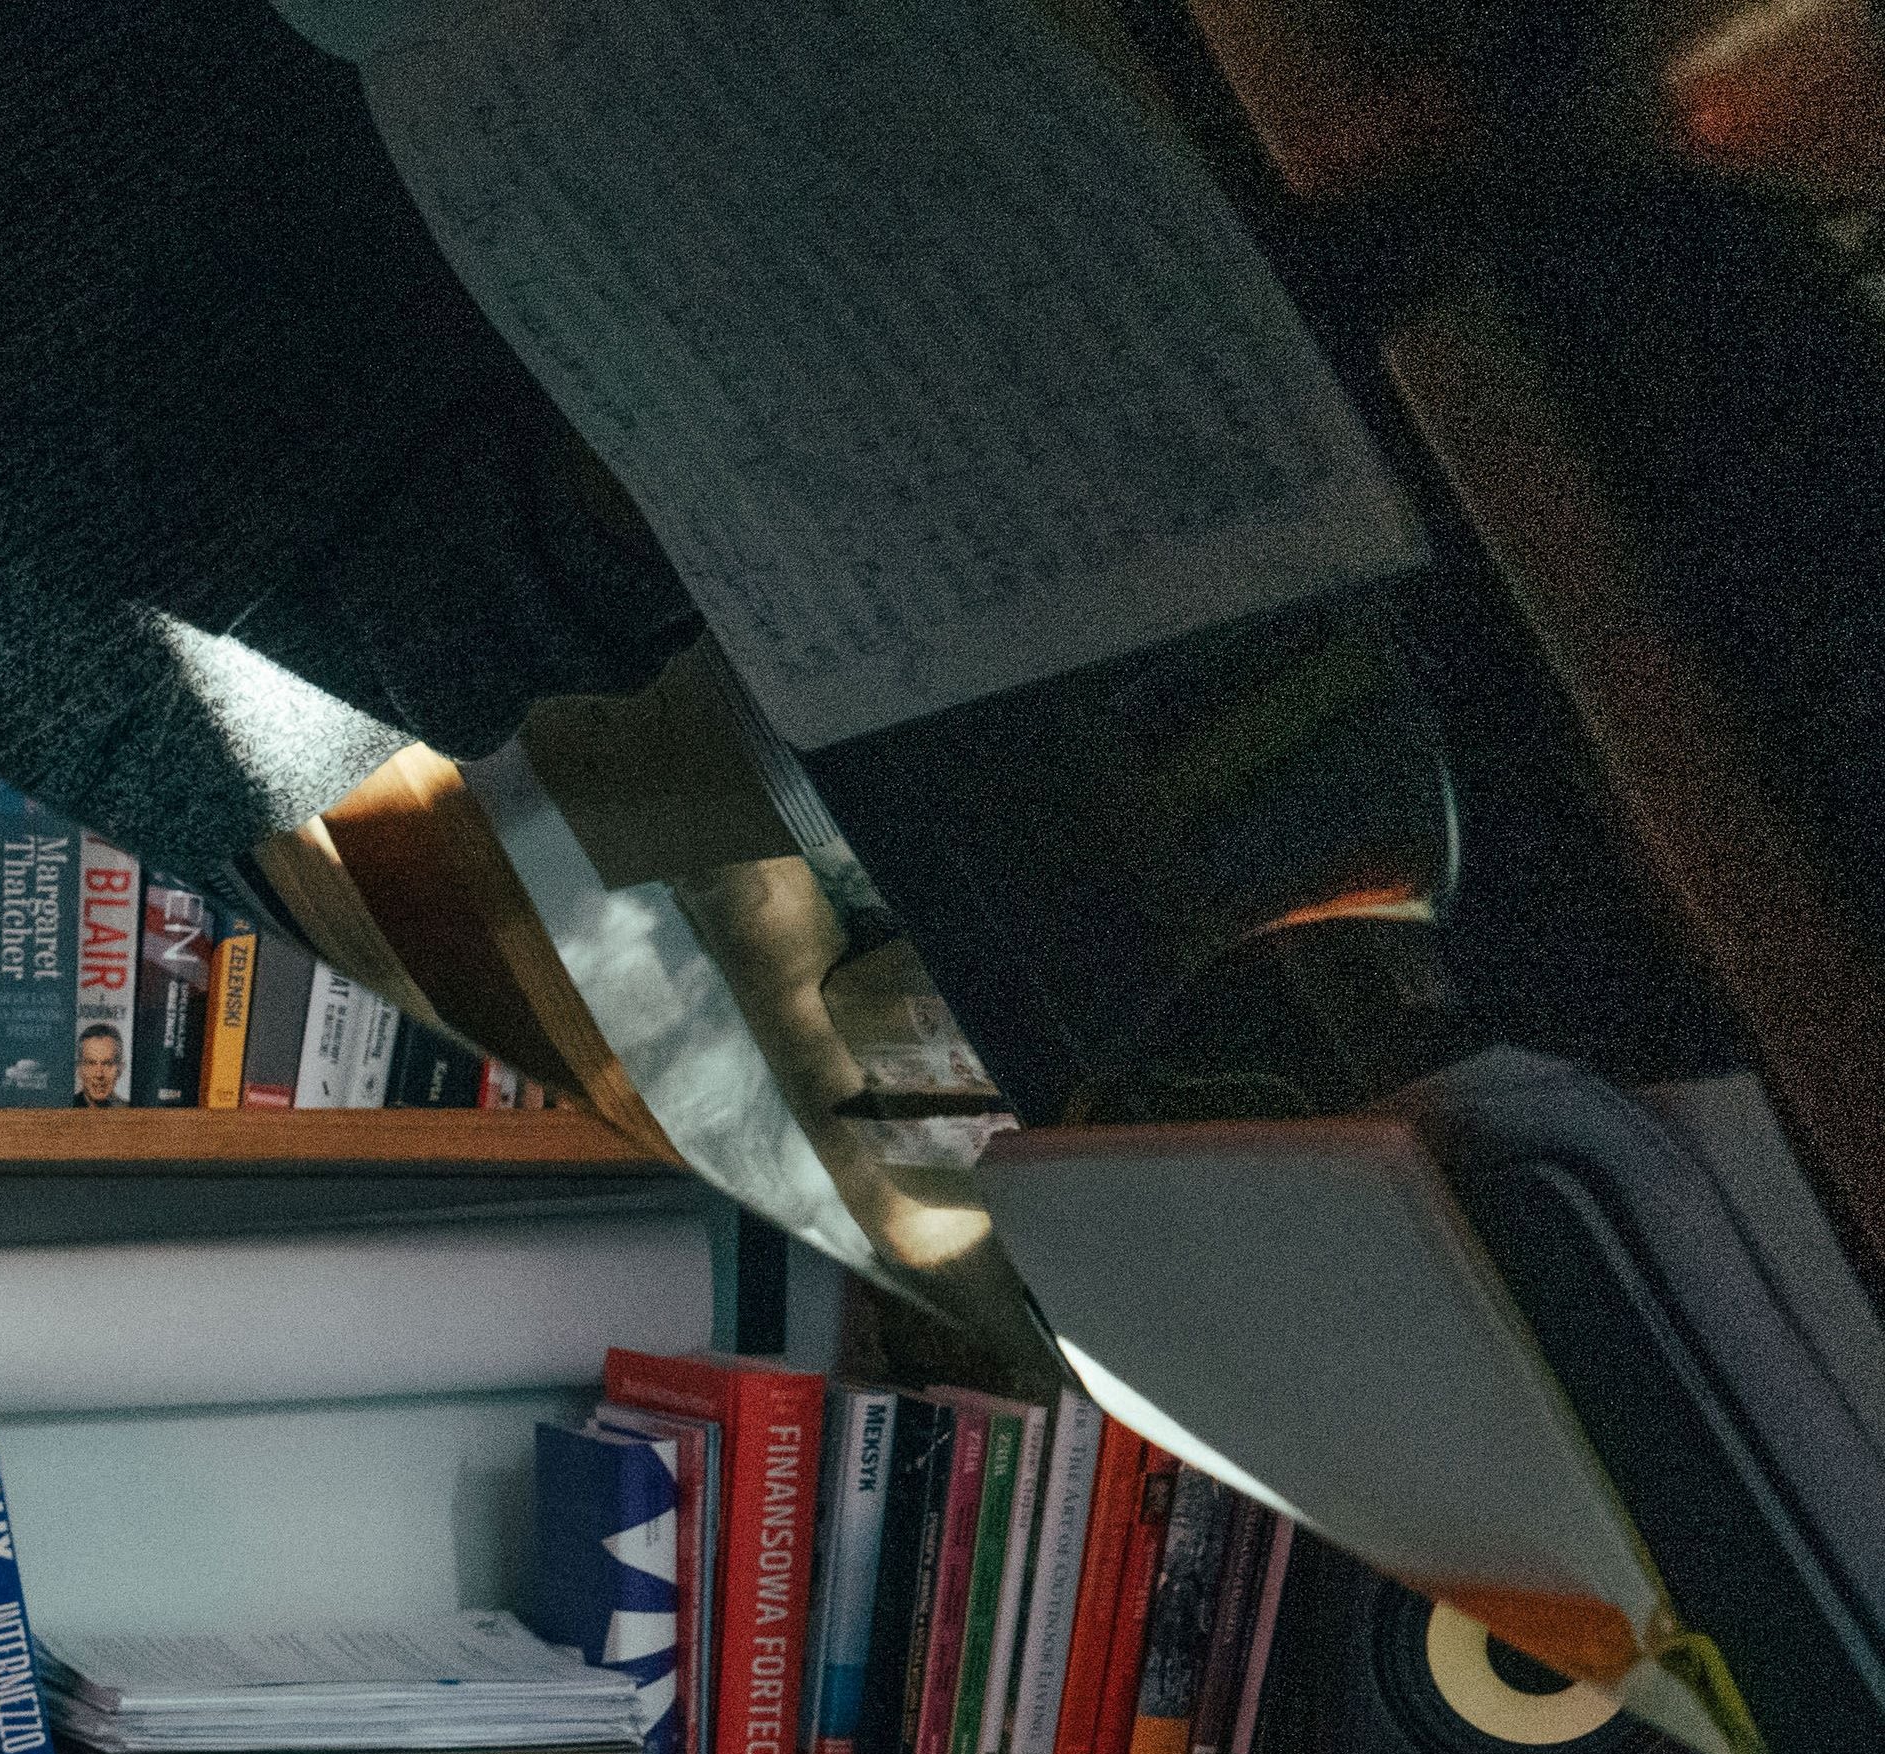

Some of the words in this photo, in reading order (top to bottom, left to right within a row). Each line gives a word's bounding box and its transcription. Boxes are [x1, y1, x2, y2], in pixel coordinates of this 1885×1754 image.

[0, 836, 36, 980] Thatcher
[32, 835, 69, 980] Margaret
[79, 867, 132, 991] BLAIR
[857, 1403, 886, 1495] MEKSYK
[754, 1424, 802, 1626] FINANSOWA
